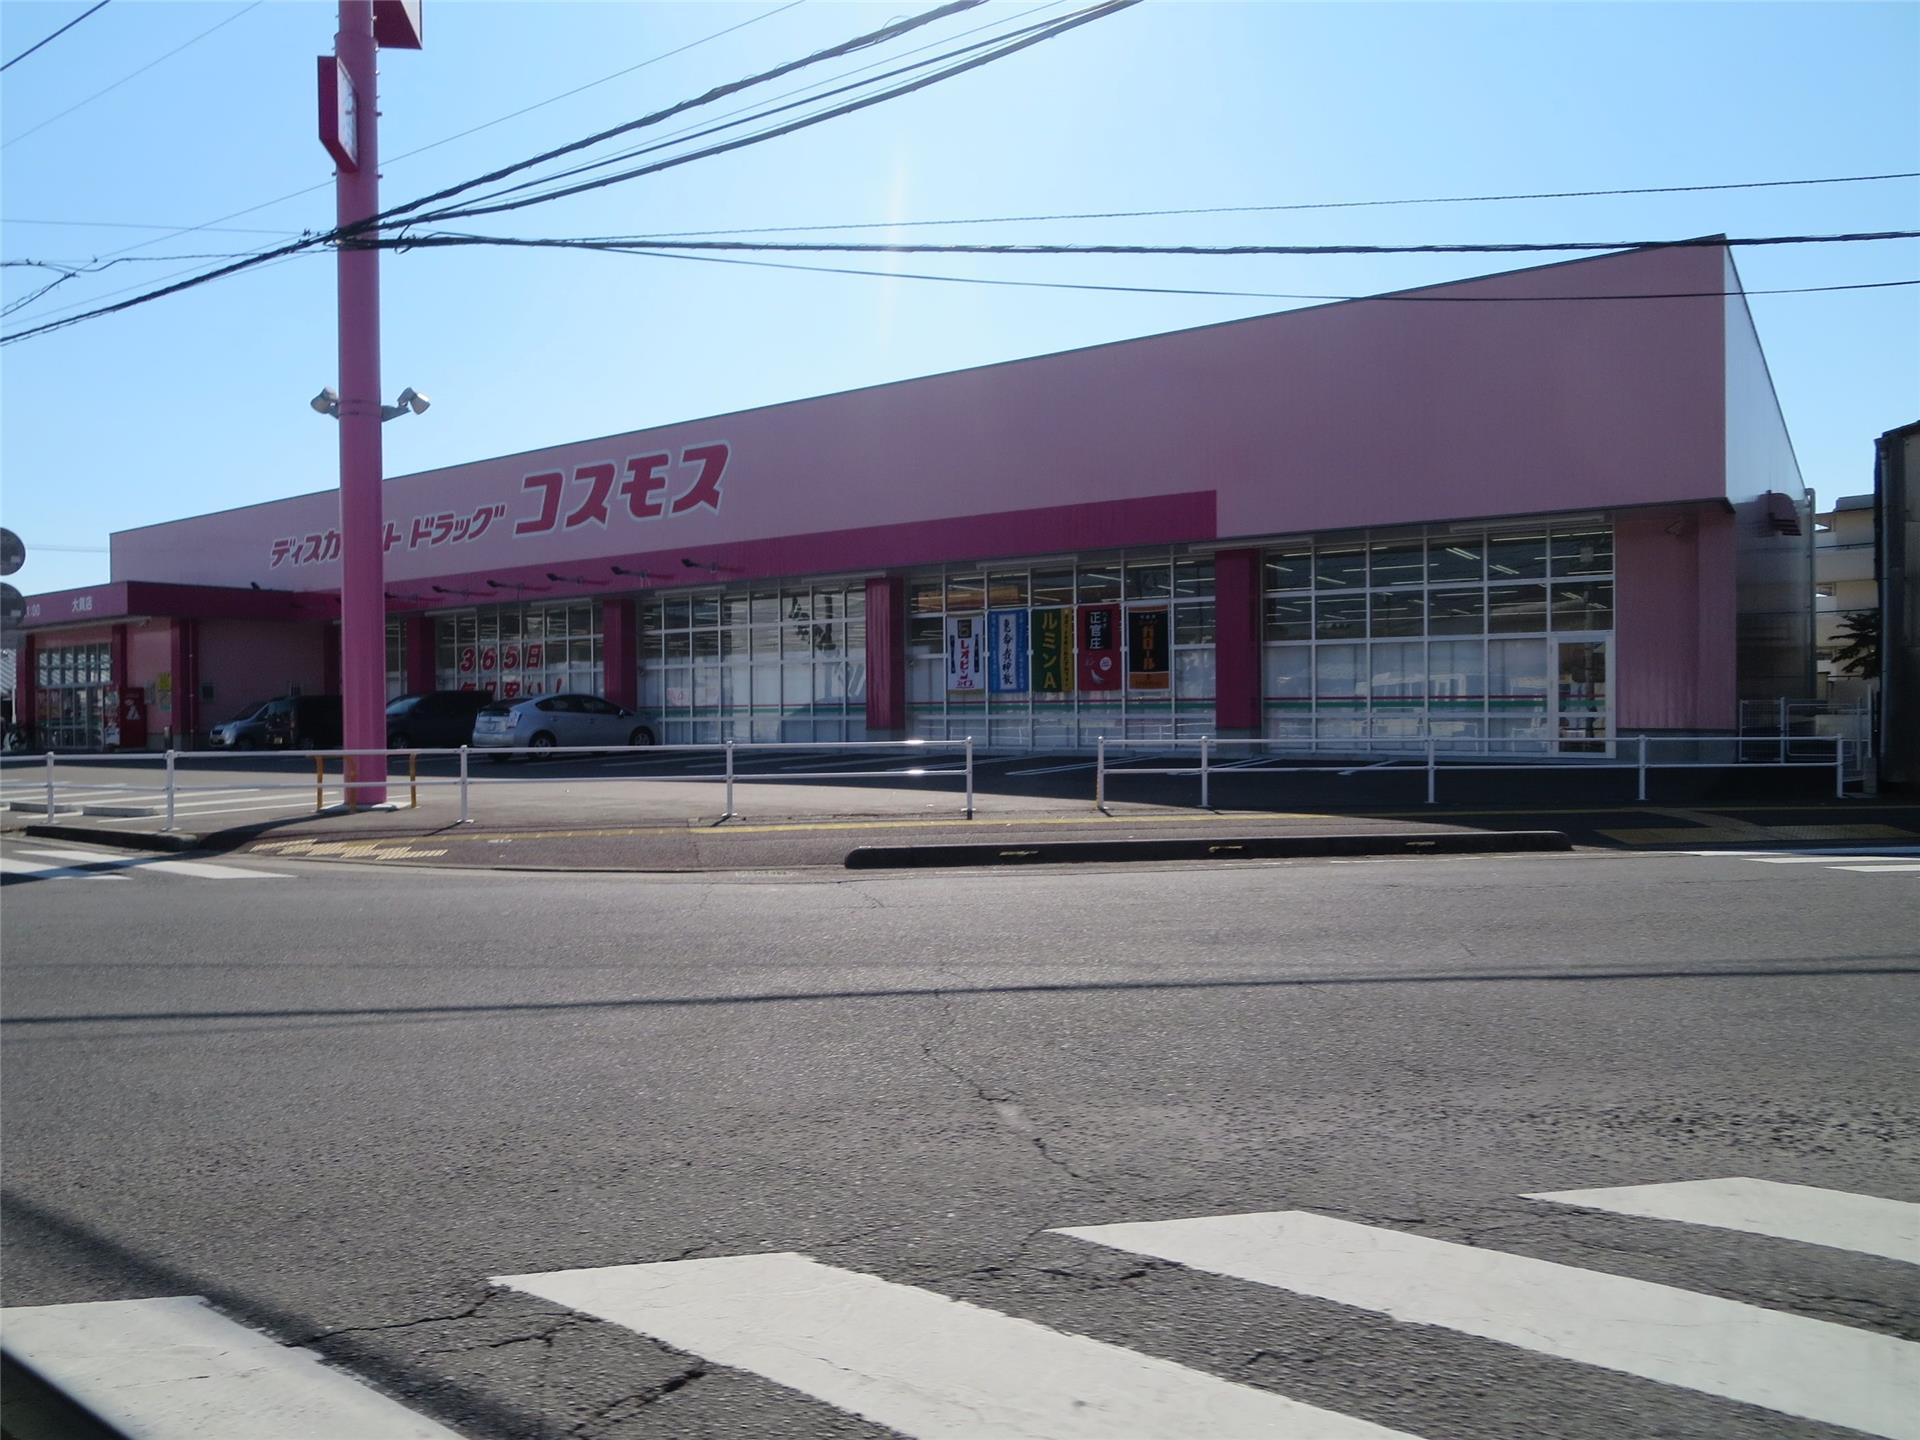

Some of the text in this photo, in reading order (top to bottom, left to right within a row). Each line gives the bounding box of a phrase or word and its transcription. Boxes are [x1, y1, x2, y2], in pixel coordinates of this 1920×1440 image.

[271, 440, 731, 569] ディスカト ドラッグ コスモス
[459, 643, 543, 673] 365日
[1041, 612, 1058, 689] ルミンA
[1089, 611, 1103, 649] 正官庄
